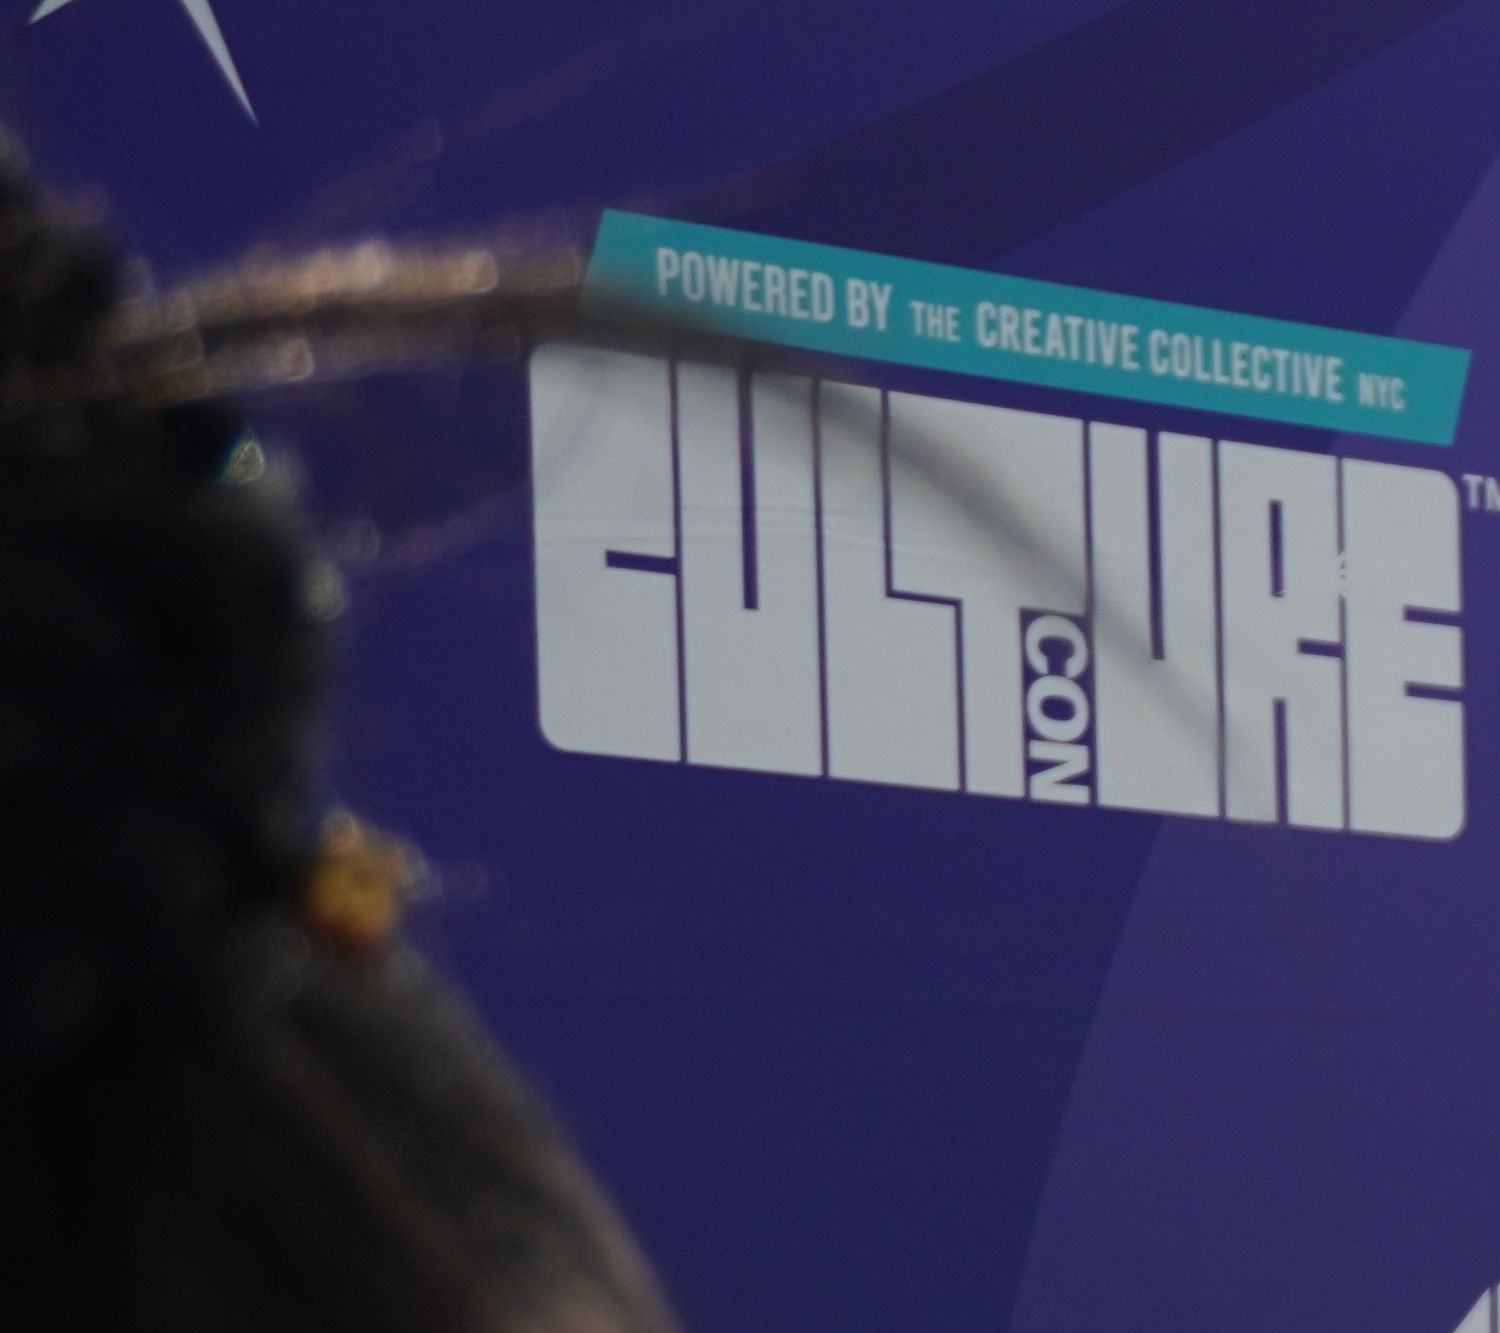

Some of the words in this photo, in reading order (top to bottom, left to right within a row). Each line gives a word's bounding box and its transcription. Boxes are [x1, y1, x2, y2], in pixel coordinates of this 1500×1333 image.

[656, 246, 835, 323] POWERED
[845, 279, 894, 333] BY
[909, 300, 961, 343] THE
[975, 300, 1142, 372] CREATIVE
[1147, 329, 1345, 402] COLLECTIVE
[1356, 371, 1407, 412] NYC
[529, 340, 1466, 842] CULTURE
[1022, 613, 1092, 806] CON
